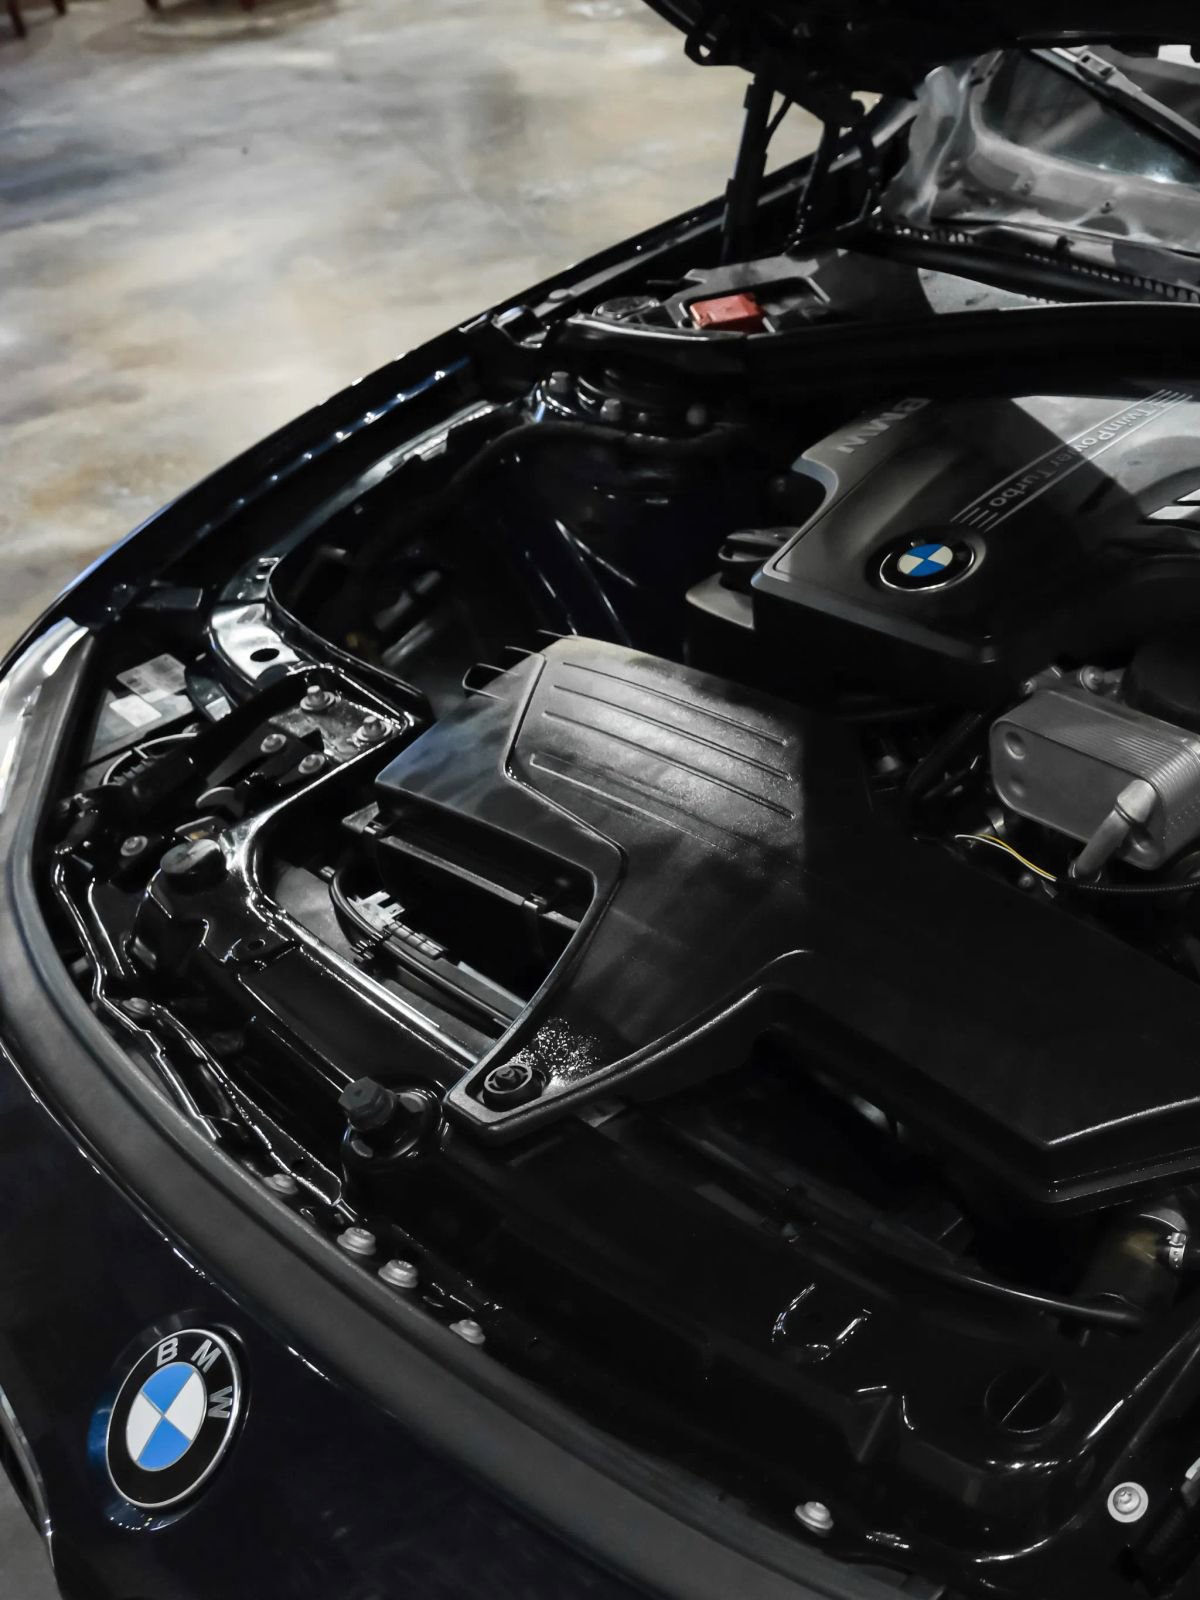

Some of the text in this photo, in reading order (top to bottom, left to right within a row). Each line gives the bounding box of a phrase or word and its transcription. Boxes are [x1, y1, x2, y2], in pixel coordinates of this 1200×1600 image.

[835, 397, 933, 454] BMW
[989, 407, 1156, 507] TwinPower Turbo
[157, 1337, 233, 1418] BMW
